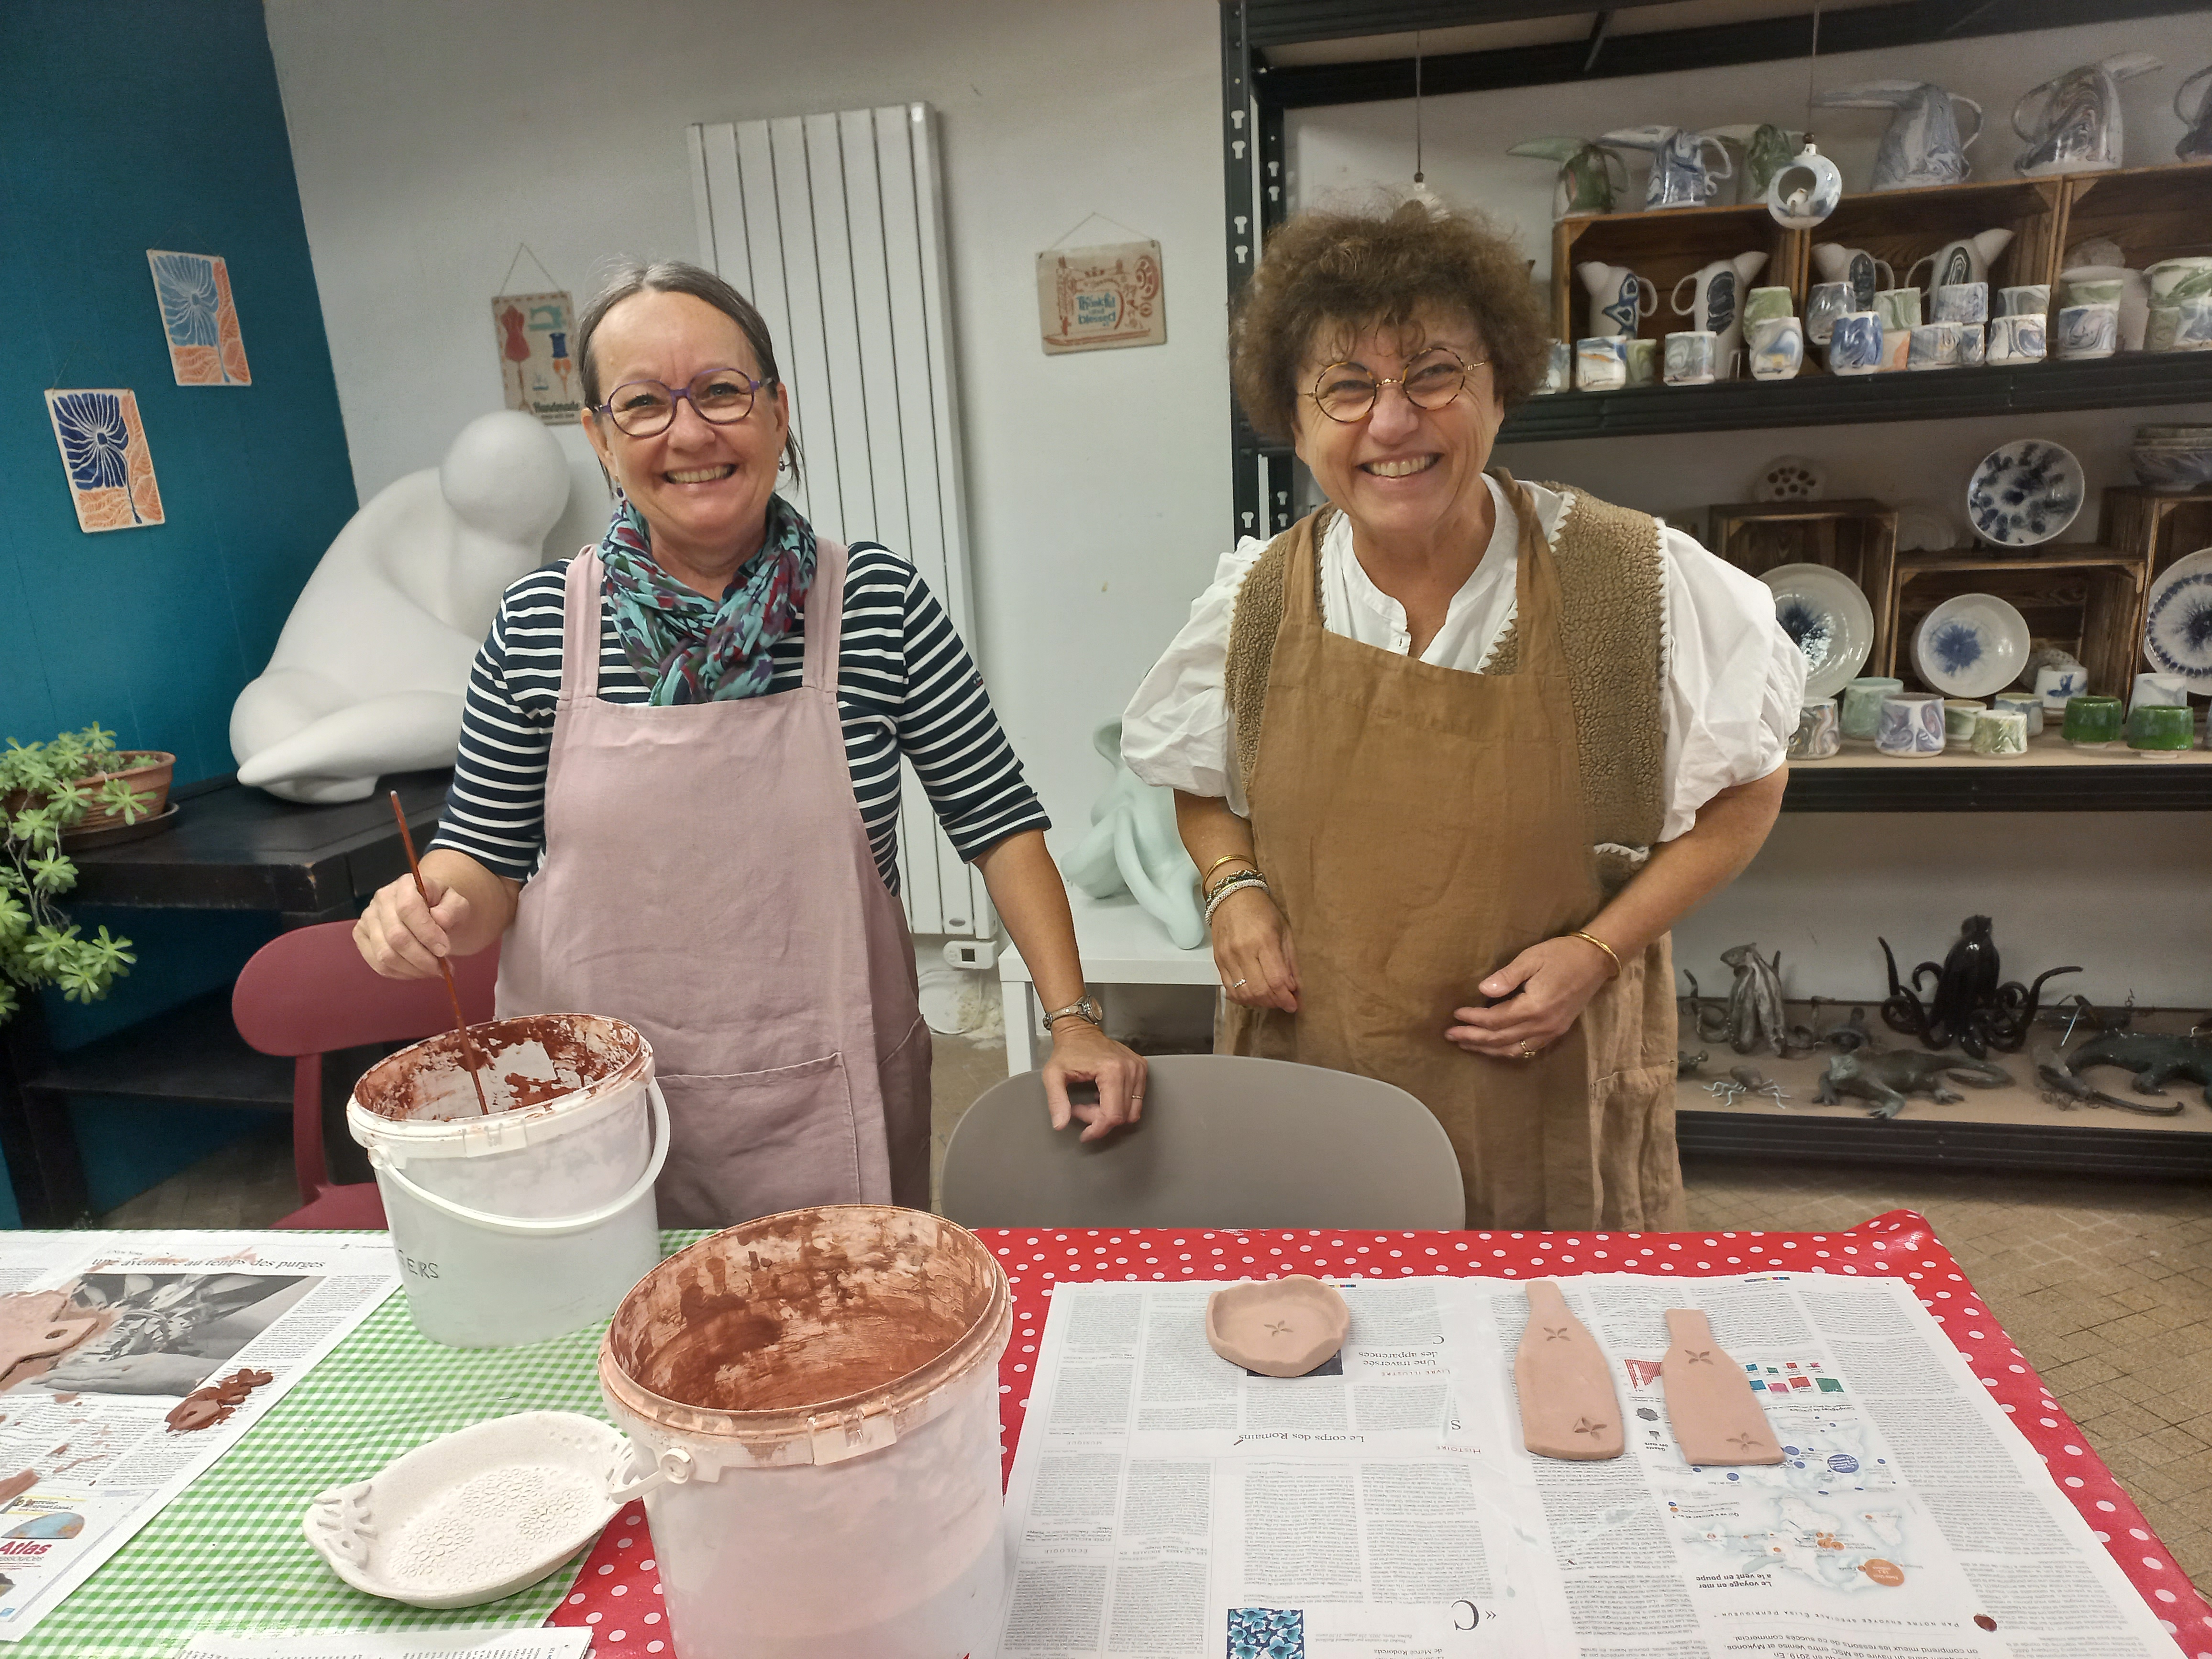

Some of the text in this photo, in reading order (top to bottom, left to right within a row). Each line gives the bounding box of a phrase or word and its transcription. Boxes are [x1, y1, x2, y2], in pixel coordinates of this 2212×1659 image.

[205, 1259, 247, 1267] temps
[251, 1258, 276, 1267] des
[275, 1261, 326, 1269] purges
[1433, 1335, 1445, 1344] C
[1450, 1420, 1461, 1430] S
[1239, 1433, 1288, 1441] Romains
[1435, 1446, 1481, 1454] HISTOIRE
[0, 1541, 52, 1555] Atlas
[1729, 1580, 1759, 1588] voyage
[1451, 1600, 1479, 1631] C
[1842, 1642, 1876, 1650] ressorts
[1831, 1648, 1851, 1657] MSC
